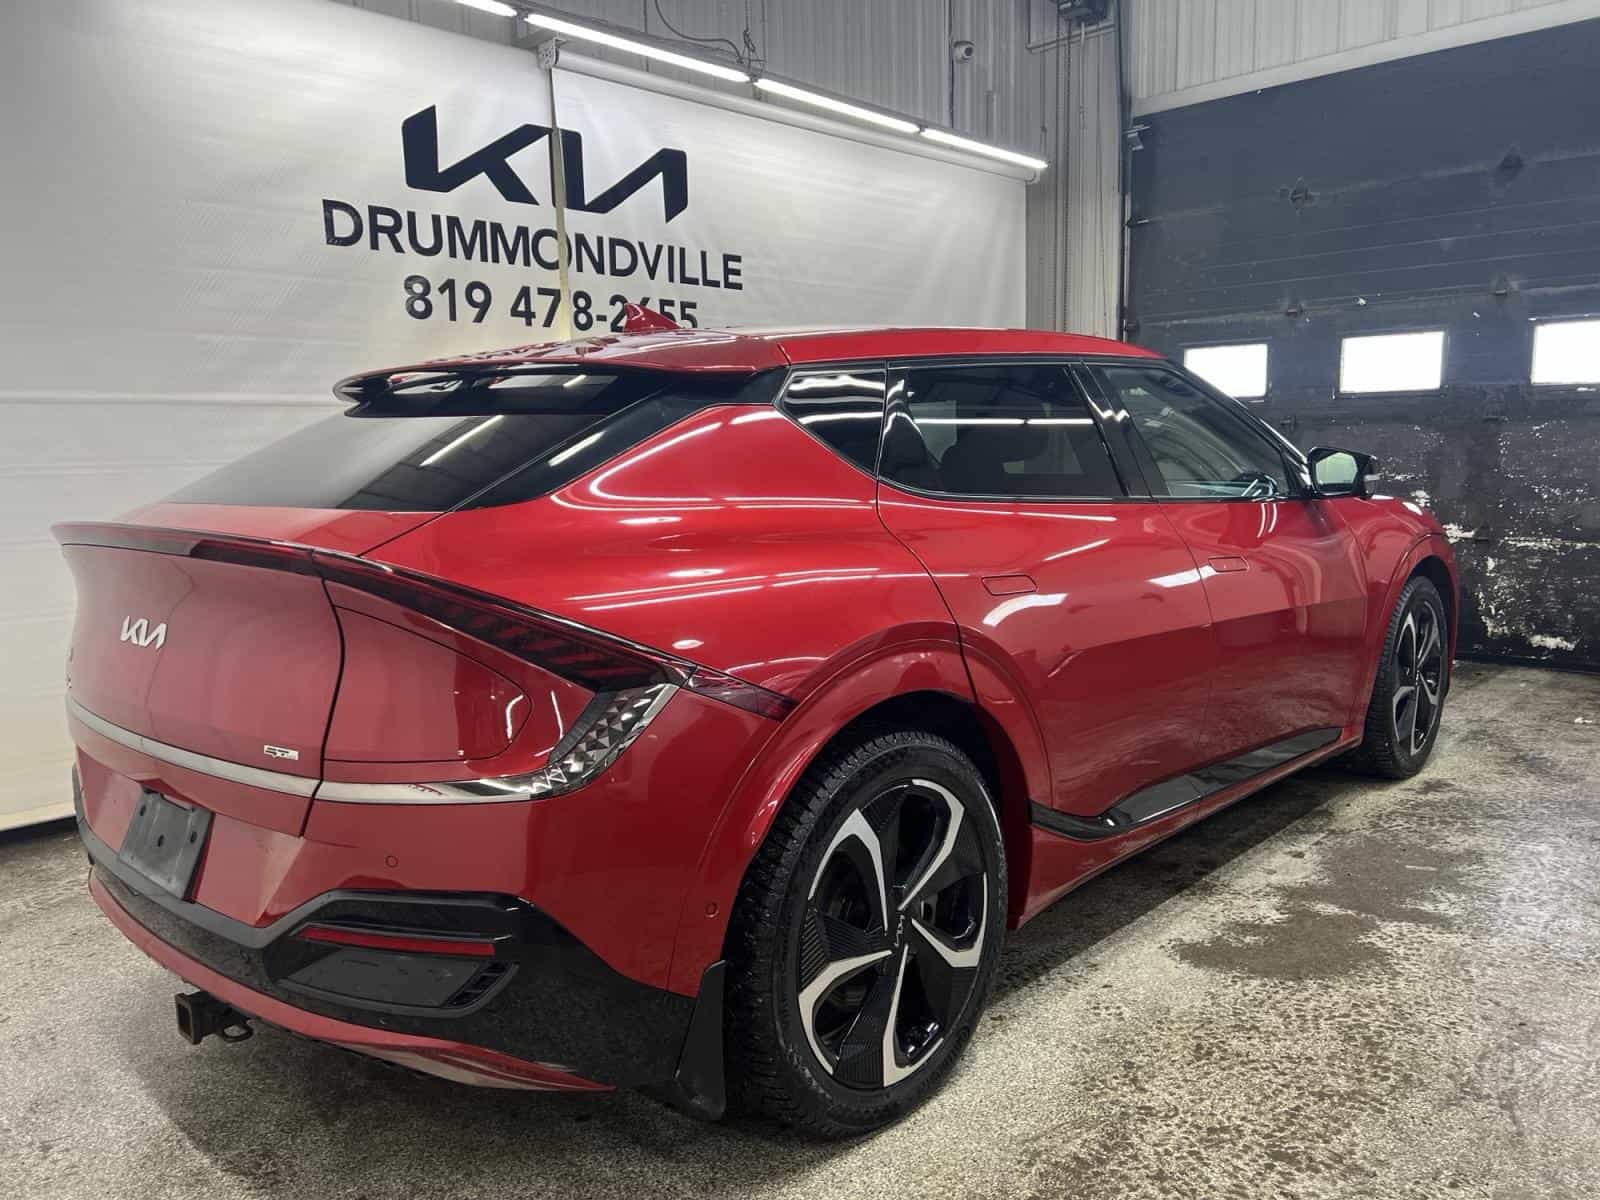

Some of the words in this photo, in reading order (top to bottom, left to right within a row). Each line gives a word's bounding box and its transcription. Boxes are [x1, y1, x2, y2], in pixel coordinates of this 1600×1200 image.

[402, 104, 688, 224] KIA
[322, 199, 744, 290] DRUMMONDVILLE
[403, 274, 493, 323] 819
[510, 285, 698, 332] 478-255
[120, 615, 168, 650] KIA
